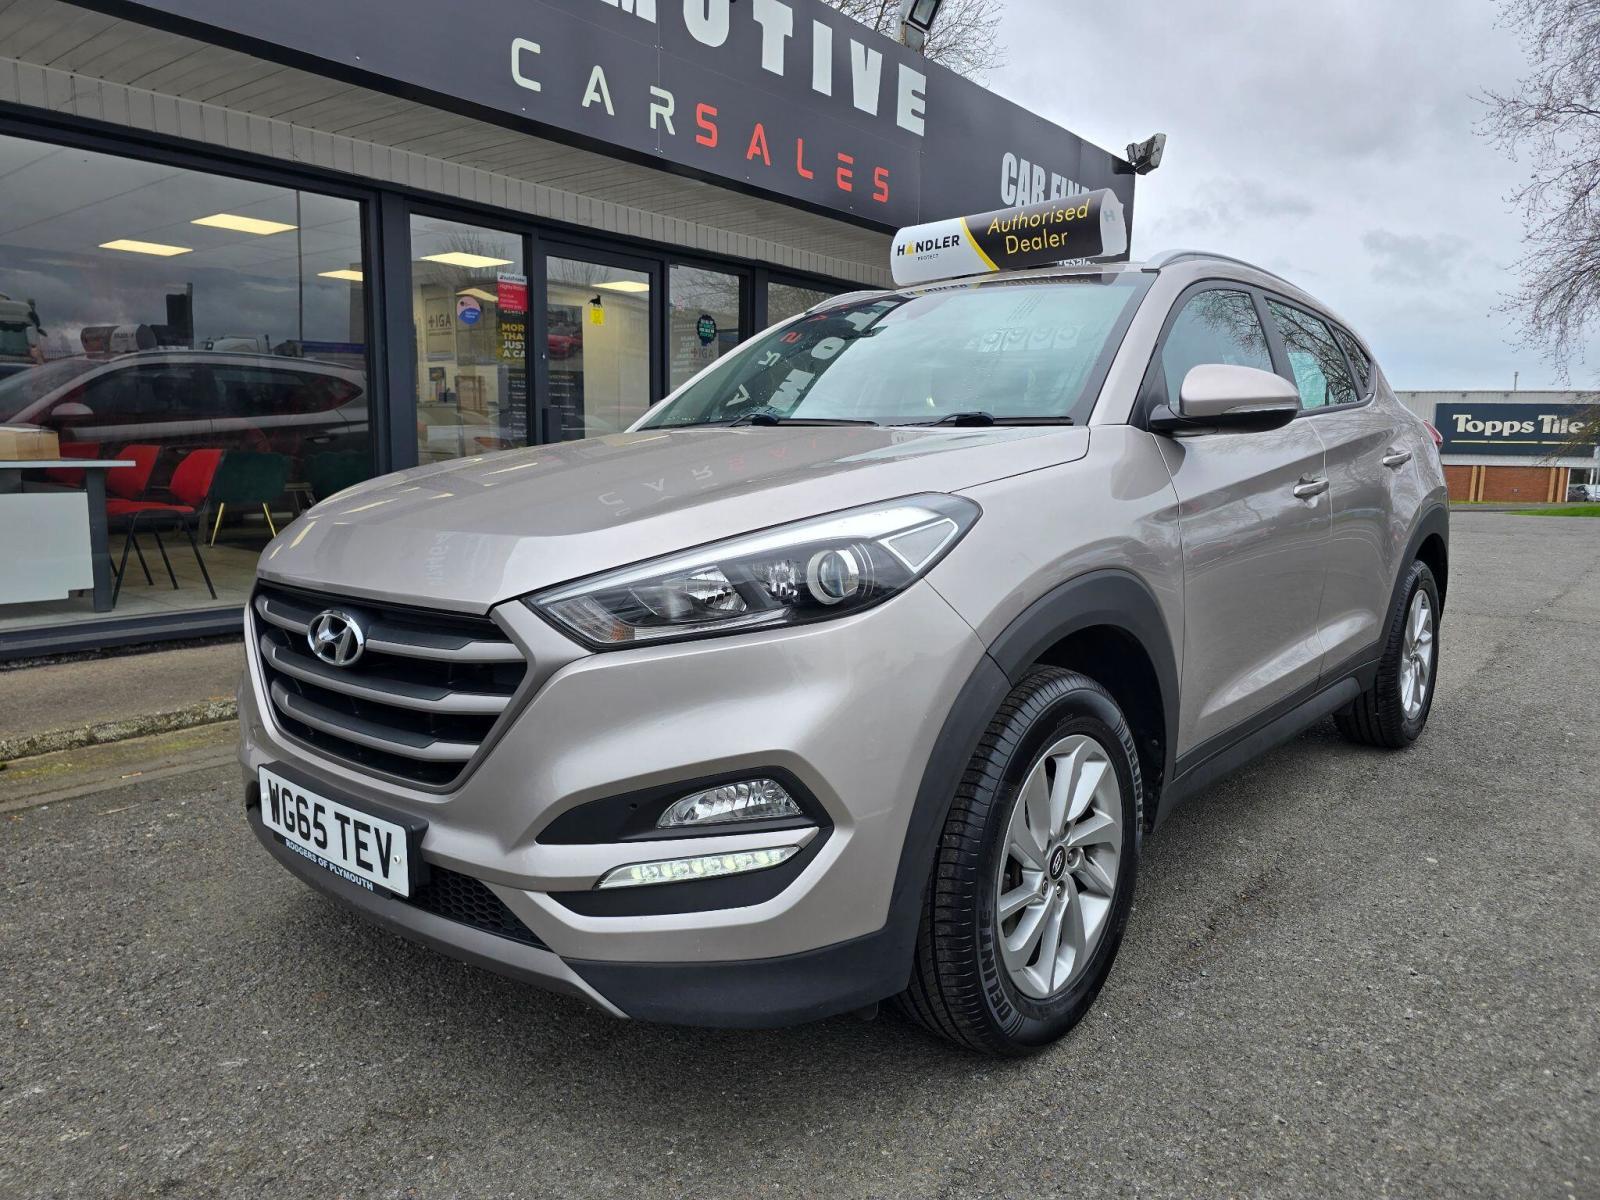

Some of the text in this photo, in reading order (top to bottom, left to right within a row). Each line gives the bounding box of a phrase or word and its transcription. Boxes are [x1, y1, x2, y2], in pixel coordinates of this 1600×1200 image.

[601, 0, 926, 137] OTIVE
[1001, 152, 1046, 207] CAR
[987, 198, 1090, 236] Authorised
[1005, 230, 1069, 254] Dealer
[502, 322, 525, 332] MOR
[502, 332, 525, 341] THA
[1452, 414, 1535, 437] Topps
[267, 778, 393, 879] WG65 TEV
[285, 838, 374, 891] RODGERS OF PLYMOUTH
